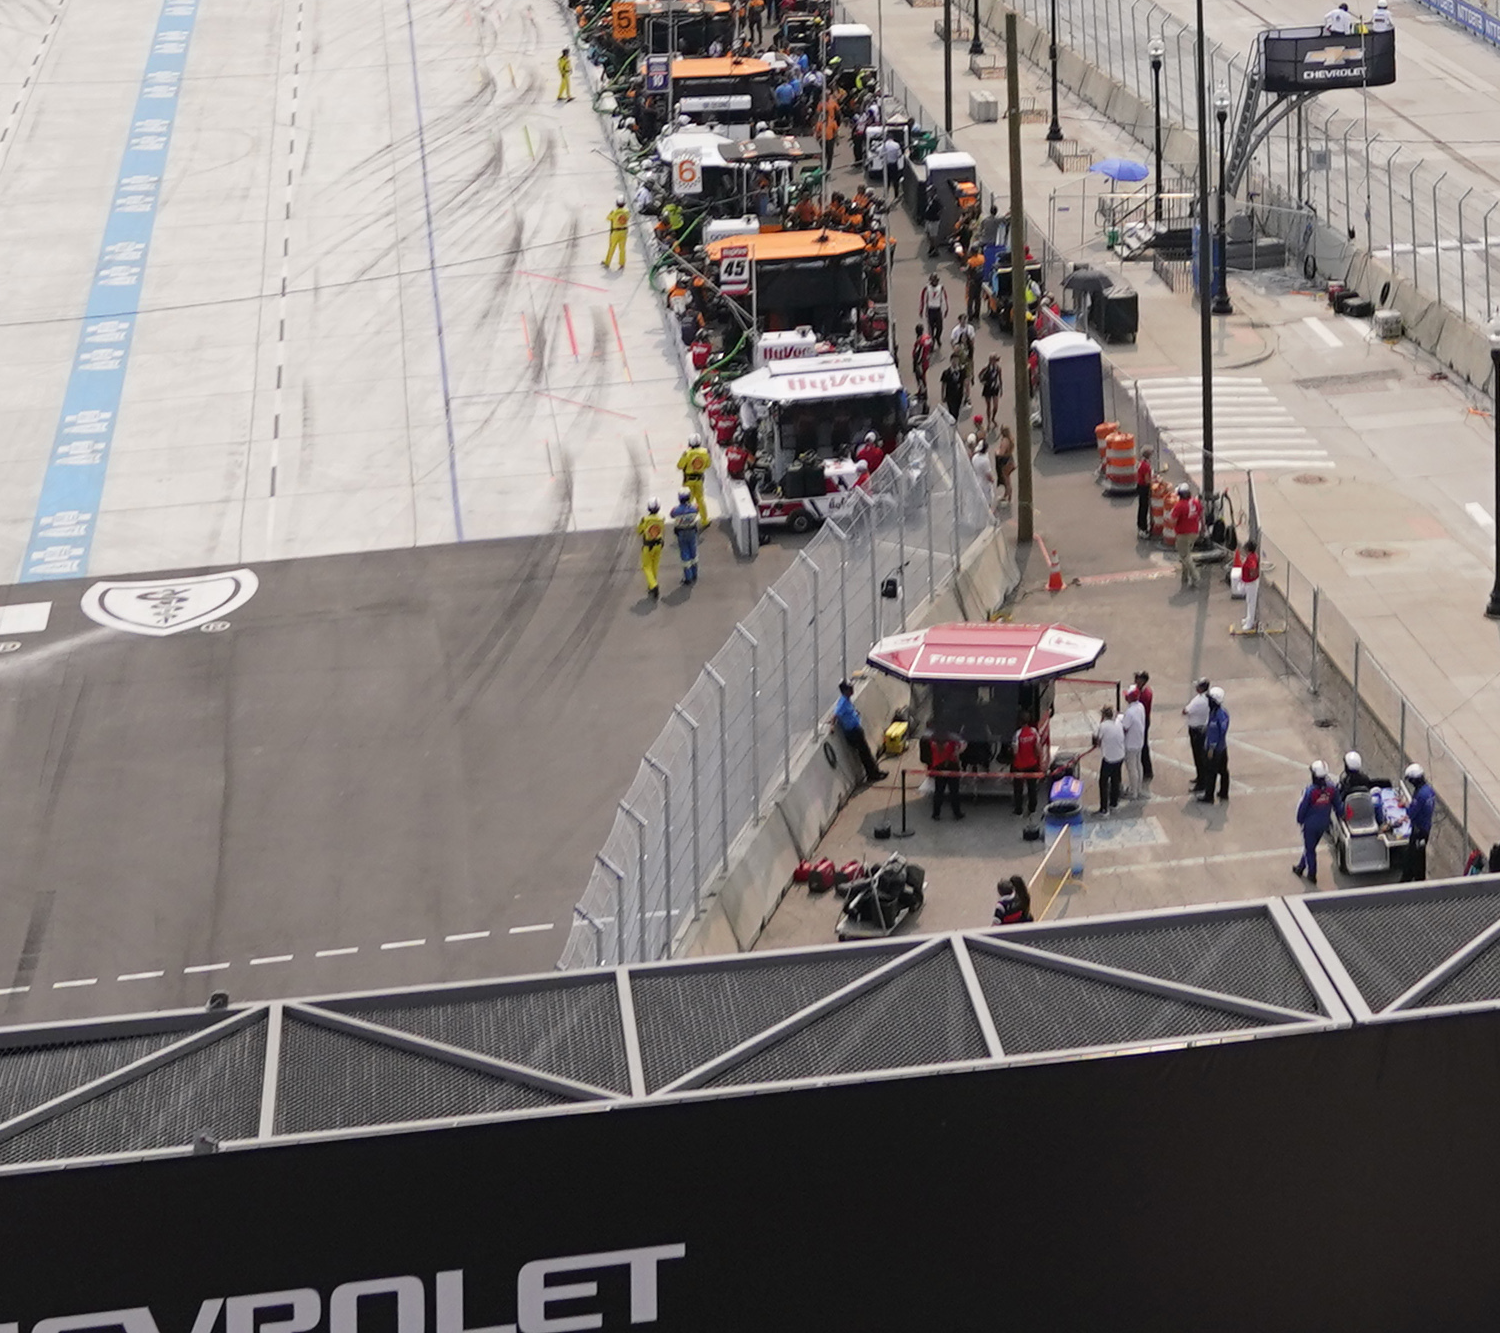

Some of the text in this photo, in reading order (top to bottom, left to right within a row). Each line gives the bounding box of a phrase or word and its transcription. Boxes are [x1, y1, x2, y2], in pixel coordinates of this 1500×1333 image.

[618, 10, 632, 29] 5
[1303, 66, 1367, 81] CHEVROLET
[678, 160, 697, 183] 6
[723, 257, 747, 276] 45
[929, 653, 1018, 668] Firestone
